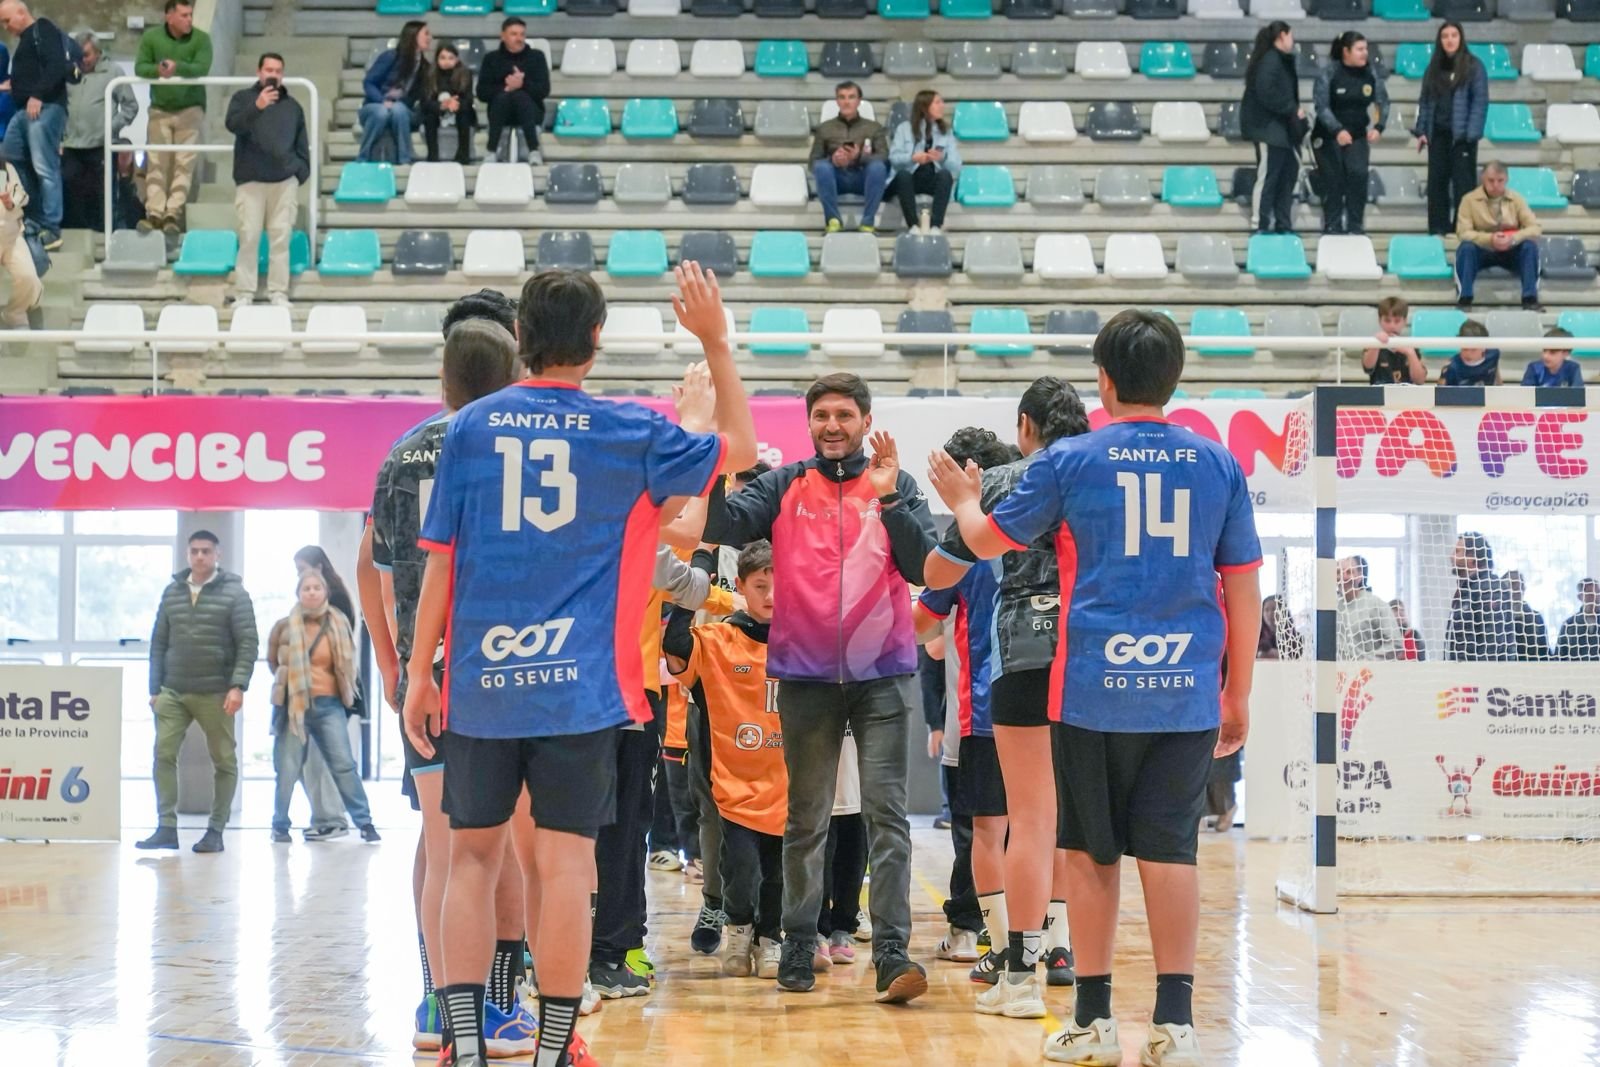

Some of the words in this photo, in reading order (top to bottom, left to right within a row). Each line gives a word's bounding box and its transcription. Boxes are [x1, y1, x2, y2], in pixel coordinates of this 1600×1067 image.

[488, 412, 559, 430] SANTA
[565, 414, 591, 430] FE
[1108, 447, 1169, 463] SANTA
[1175, 449, 1198, 463] FE
[1477, 411, 1589, 479] FE
[494, 436, 577, 532] 13
[1116, 471, 1191, 557] 14
[481, 617, 576, 662] GO7
[1104, 633, 1194, 665] GO7
[481, 673, 506, 689] GO
[514, 666, 578, 687] SEVEN
[1104, 676, 1128, 689] GO
[1136, 675, 1195, 689] SEVEN
[50, 691, 91, 721] Fe
[1486, 687, 1597, 718] Santa
[15, 727, 26, 738] la
[29, 727, 89, 739] Provincia
[1487, 723, 1546, 735] Gobierno
[60, 766, 90, 804] 6
